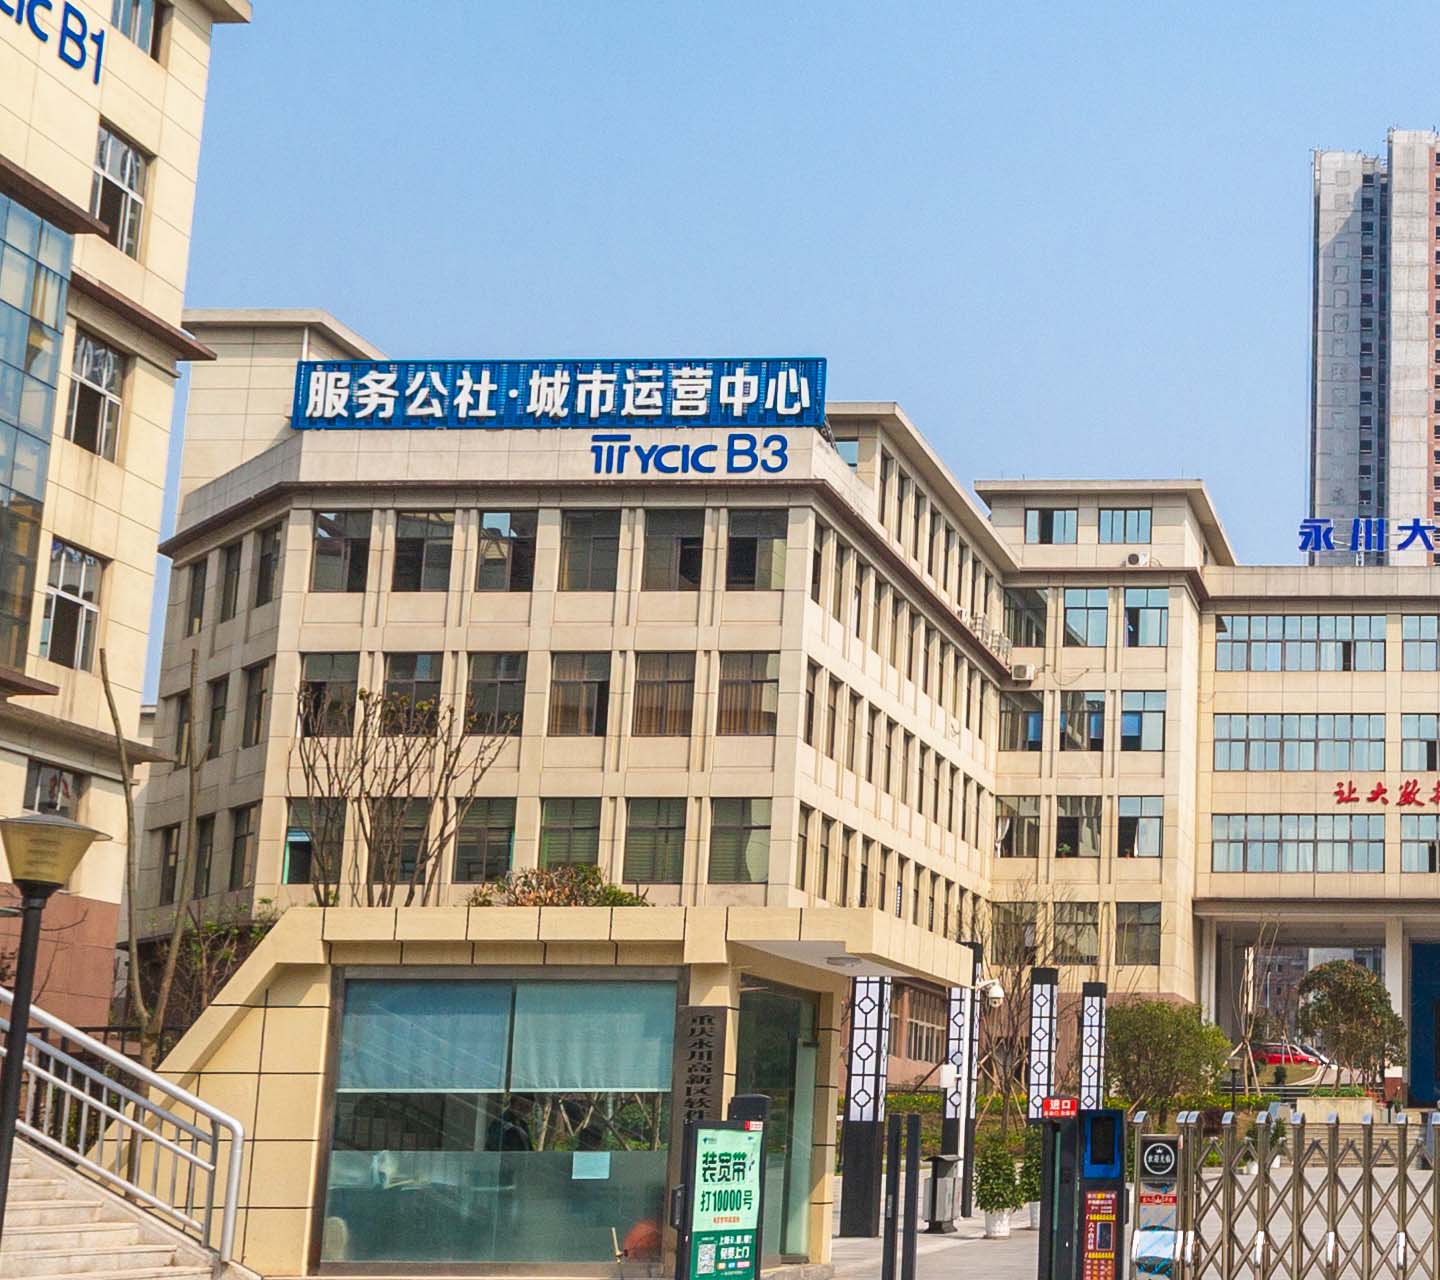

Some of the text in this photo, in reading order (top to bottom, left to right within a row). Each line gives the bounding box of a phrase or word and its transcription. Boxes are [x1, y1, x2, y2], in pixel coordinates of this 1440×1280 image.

[58, 0, 105, 86] B1
[304, 367, 811, 420] 服务公社·城市运营中心
[725, 432, 789, 474] B3
[702, 1151, 748, 1184] 装宽带
[700, 1189, 754, 1213] 打10000号
